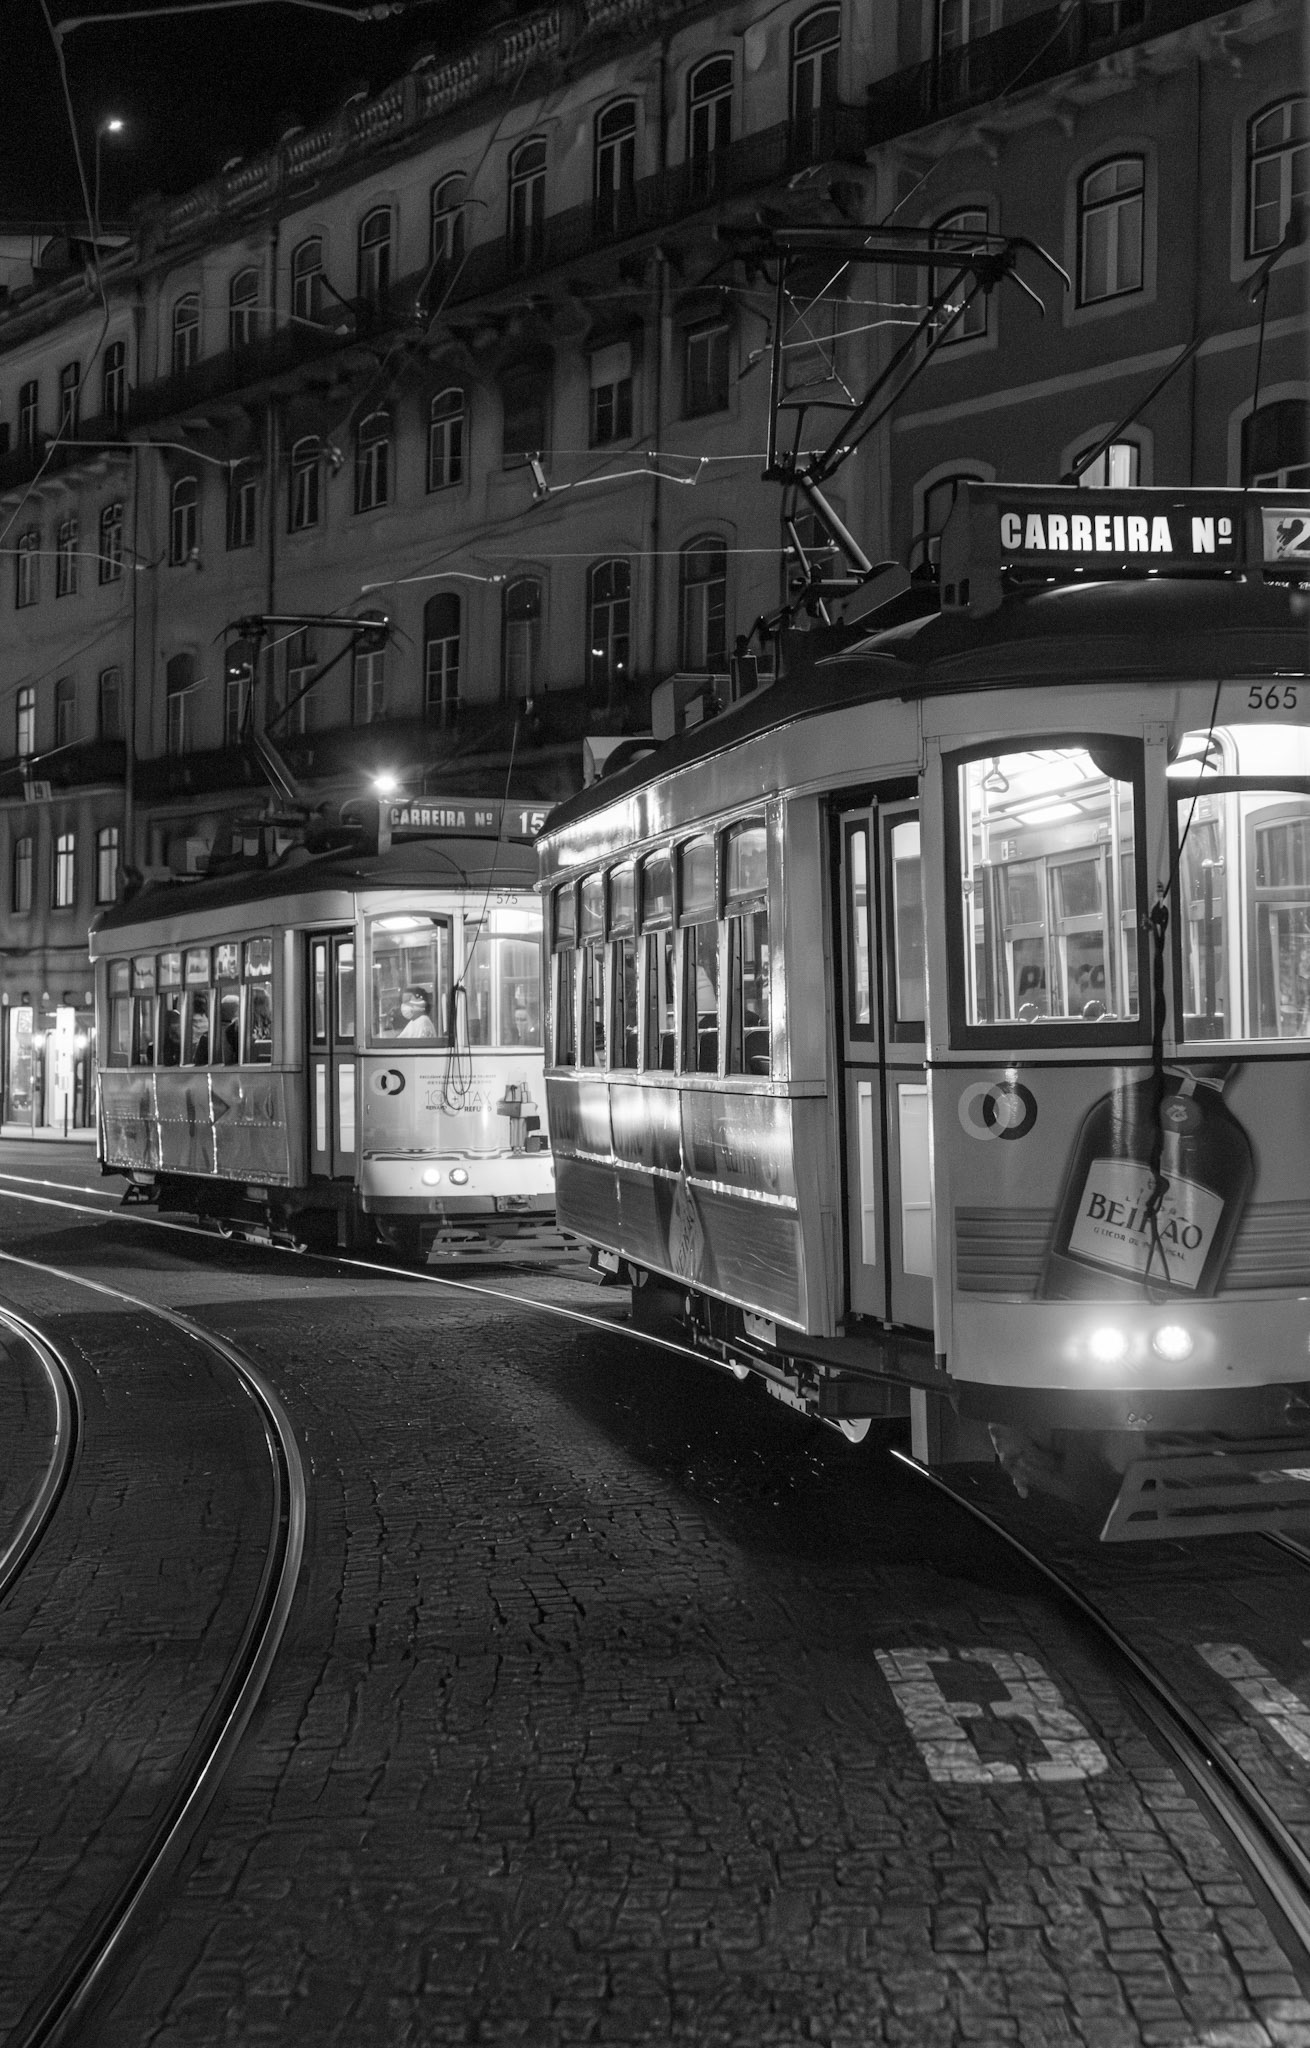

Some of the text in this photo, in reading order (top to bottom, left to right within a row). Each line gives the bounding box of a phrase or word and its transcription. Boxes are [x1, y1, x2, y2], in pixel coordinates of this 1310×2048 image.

[1000, 512, 1233, 554] CARREIRA Nº
[1247, 686, 1297, 709] 565
[390, 808, 466, 828] CARREIRA
[519, 811, 546, 835] 15
[496, 893, 518, 905] 575
